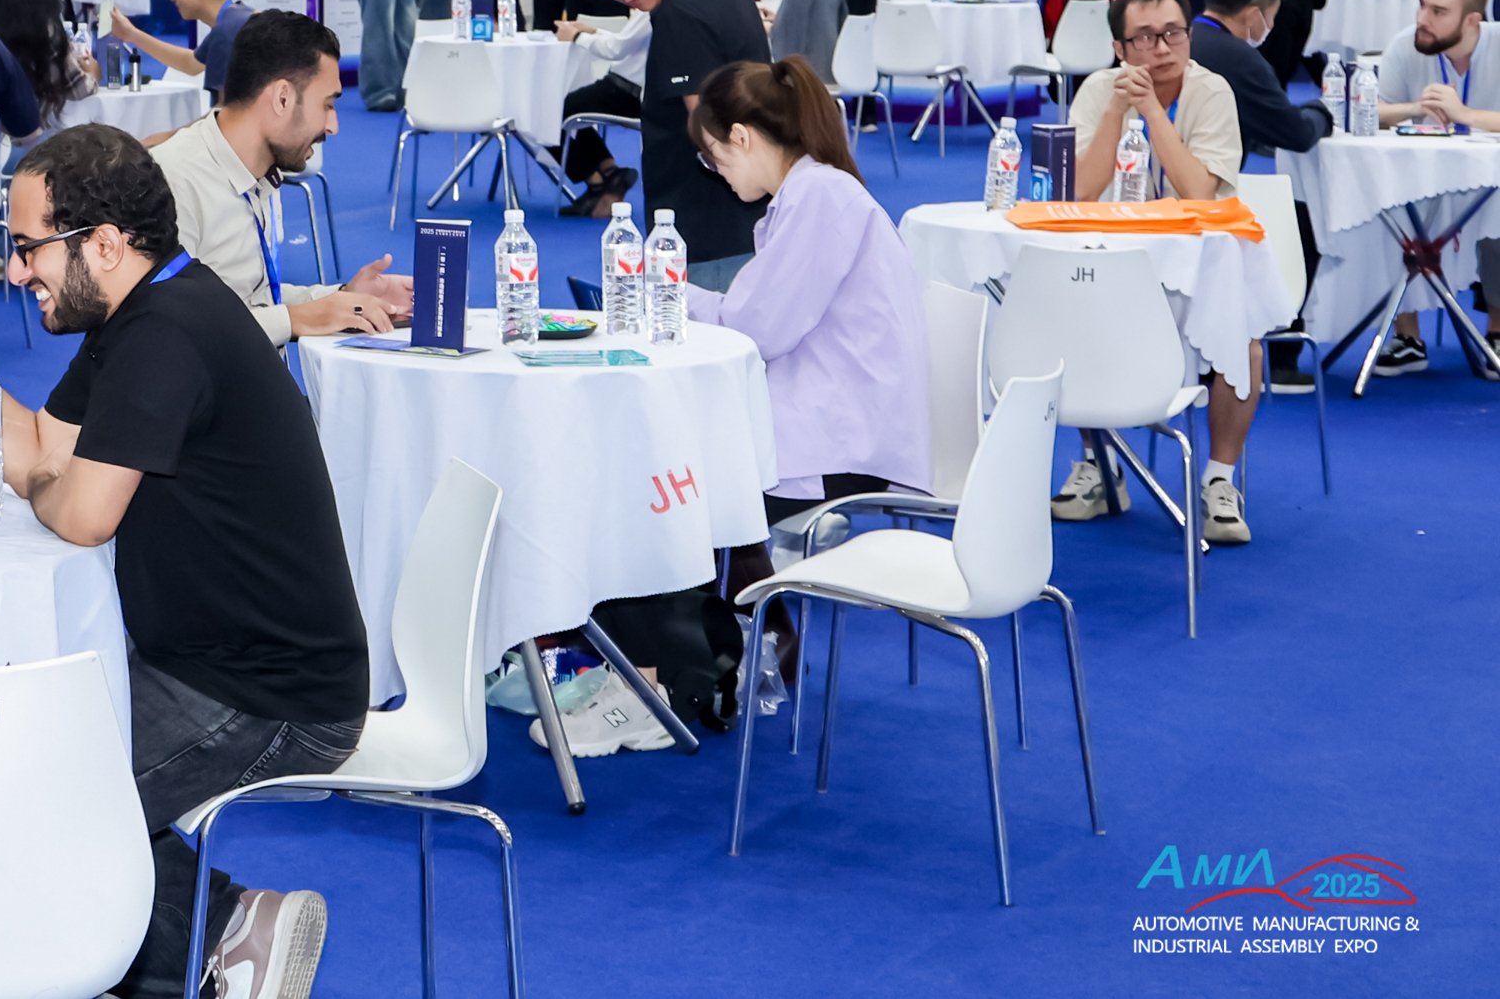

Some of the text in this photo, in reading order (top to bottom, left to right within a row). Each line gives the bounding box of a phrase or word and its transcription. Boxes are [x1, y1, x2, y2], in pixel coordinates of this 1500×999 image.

[420, 227, 434, 235] 2025
[1071, 266, 1095, 283] JH
[650, 464, 699, 514] JH
